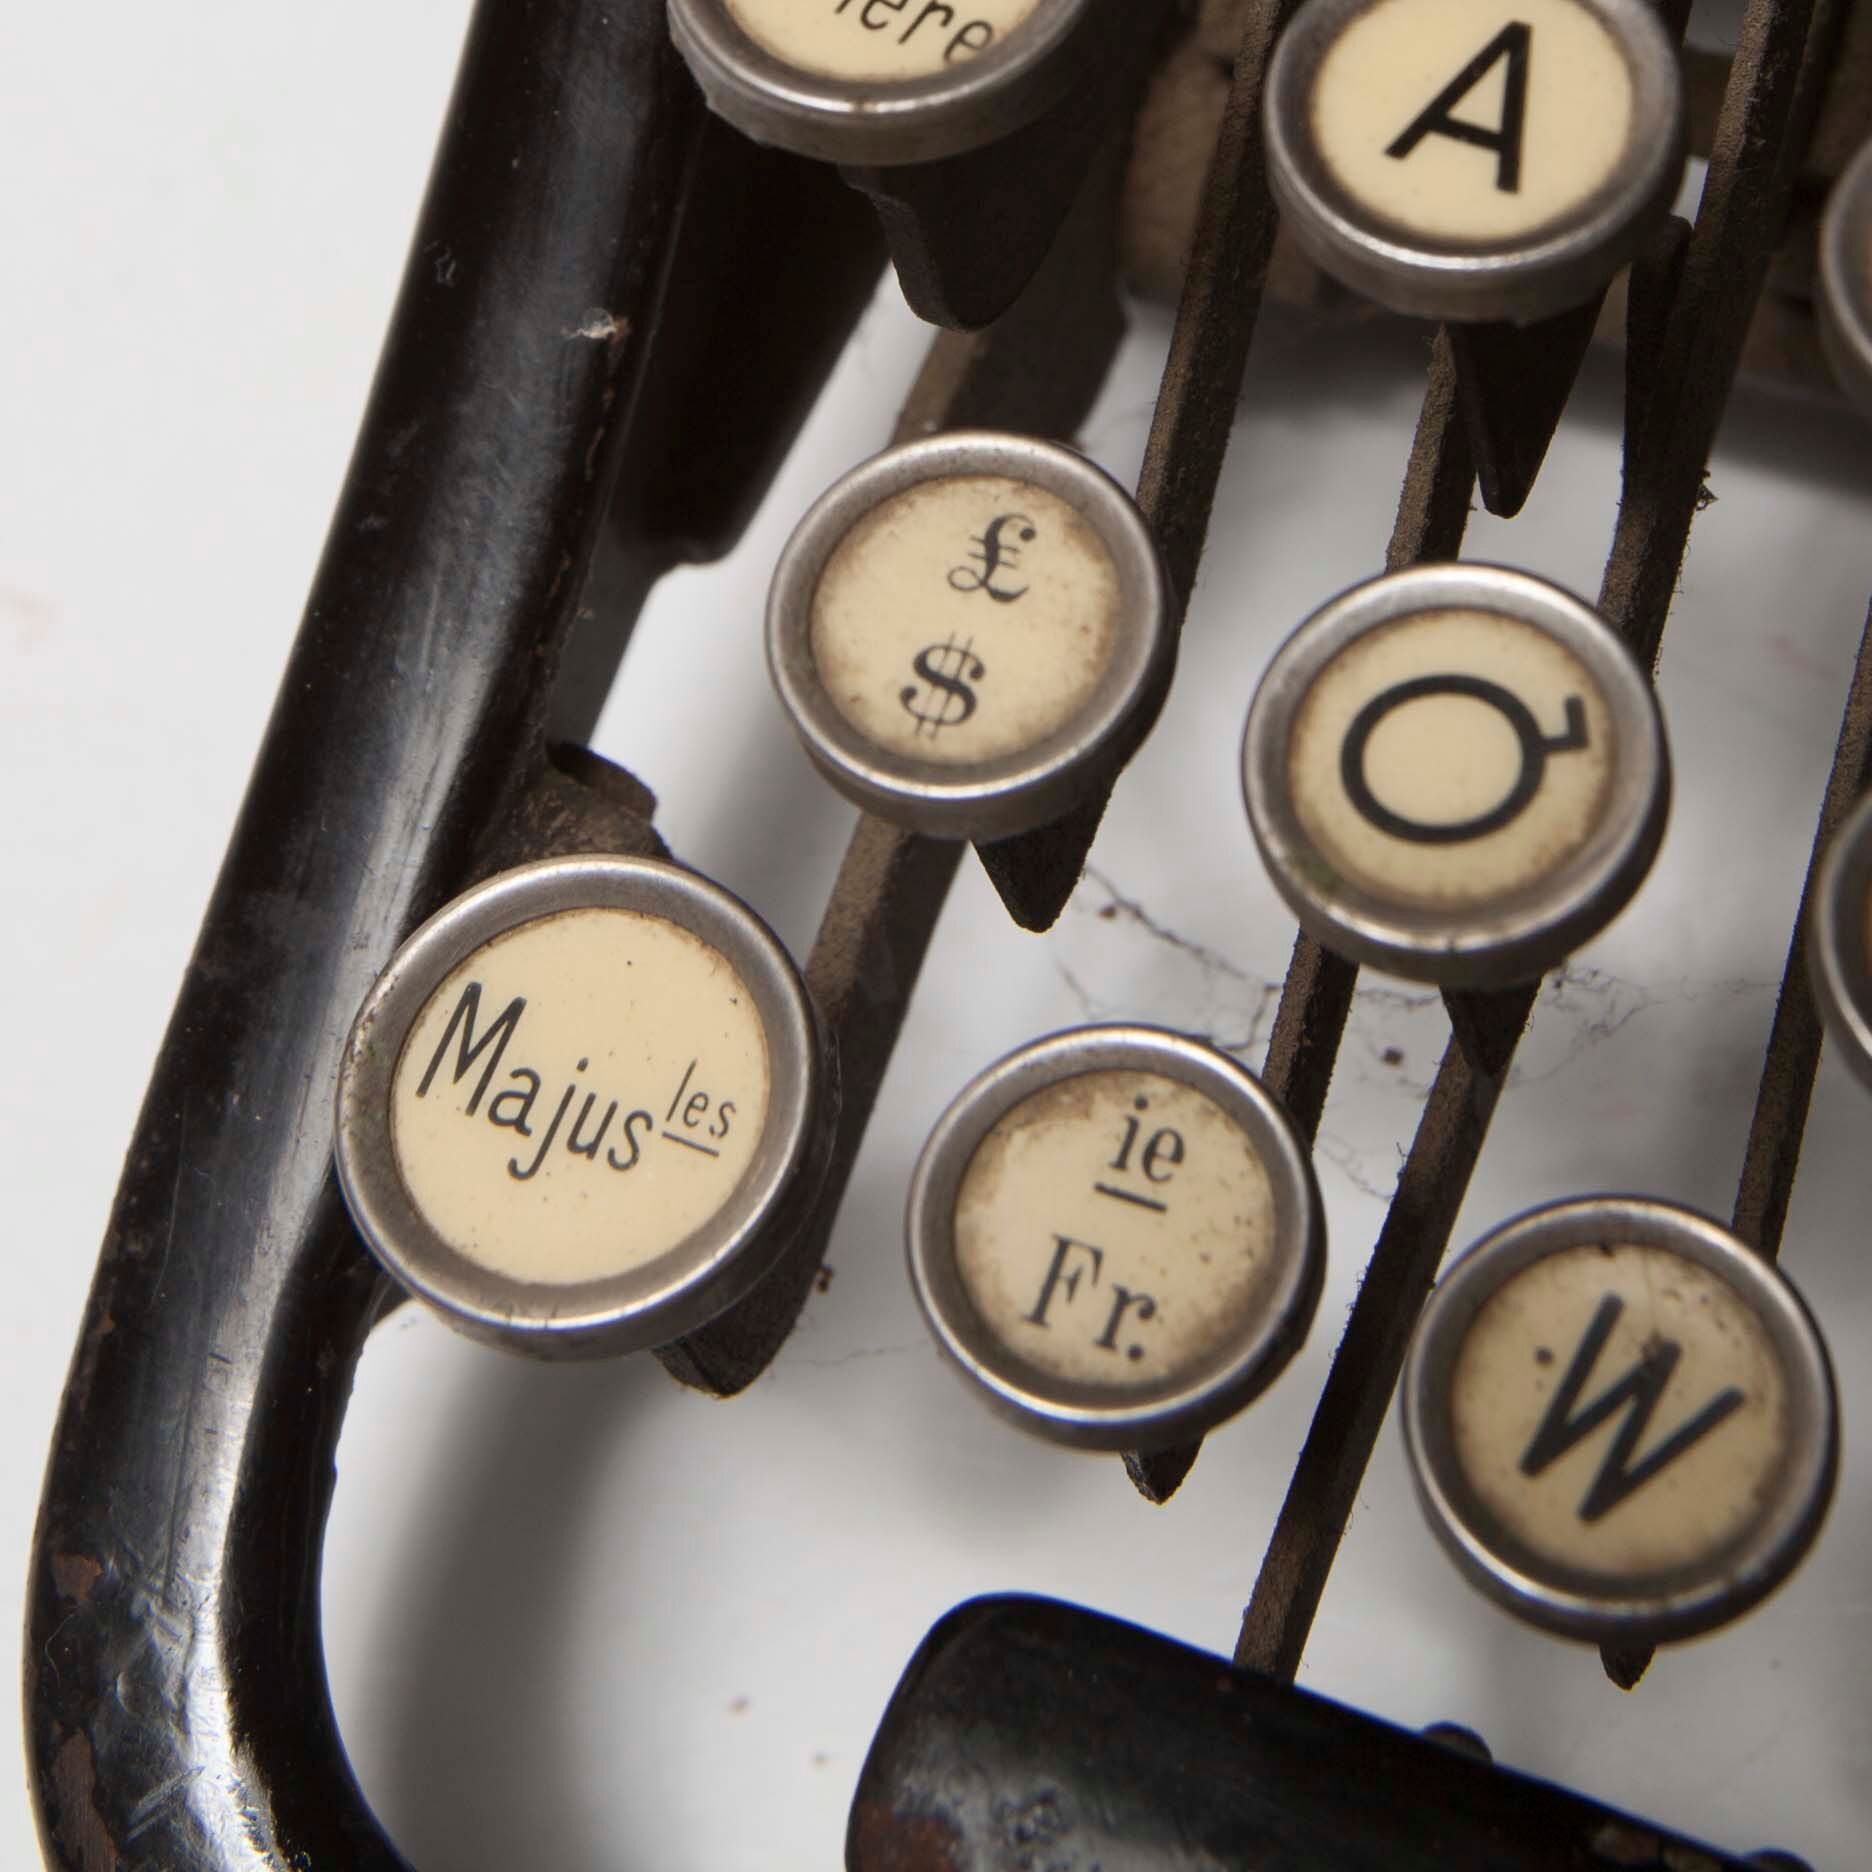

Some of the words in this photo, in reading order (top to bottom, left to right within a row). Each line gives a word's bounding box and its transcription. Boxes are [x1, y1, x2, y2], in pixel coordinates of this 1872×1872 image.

[1384, 20, 1534, 195] A
[946, 512, 1038, 605] £
[899, 633, 986, 740] $
[1341, 672, 1593, 845] Q
[1021, 1232, 1159, 1364] Fr.
[1519, 1293, 1747, 1525] W
